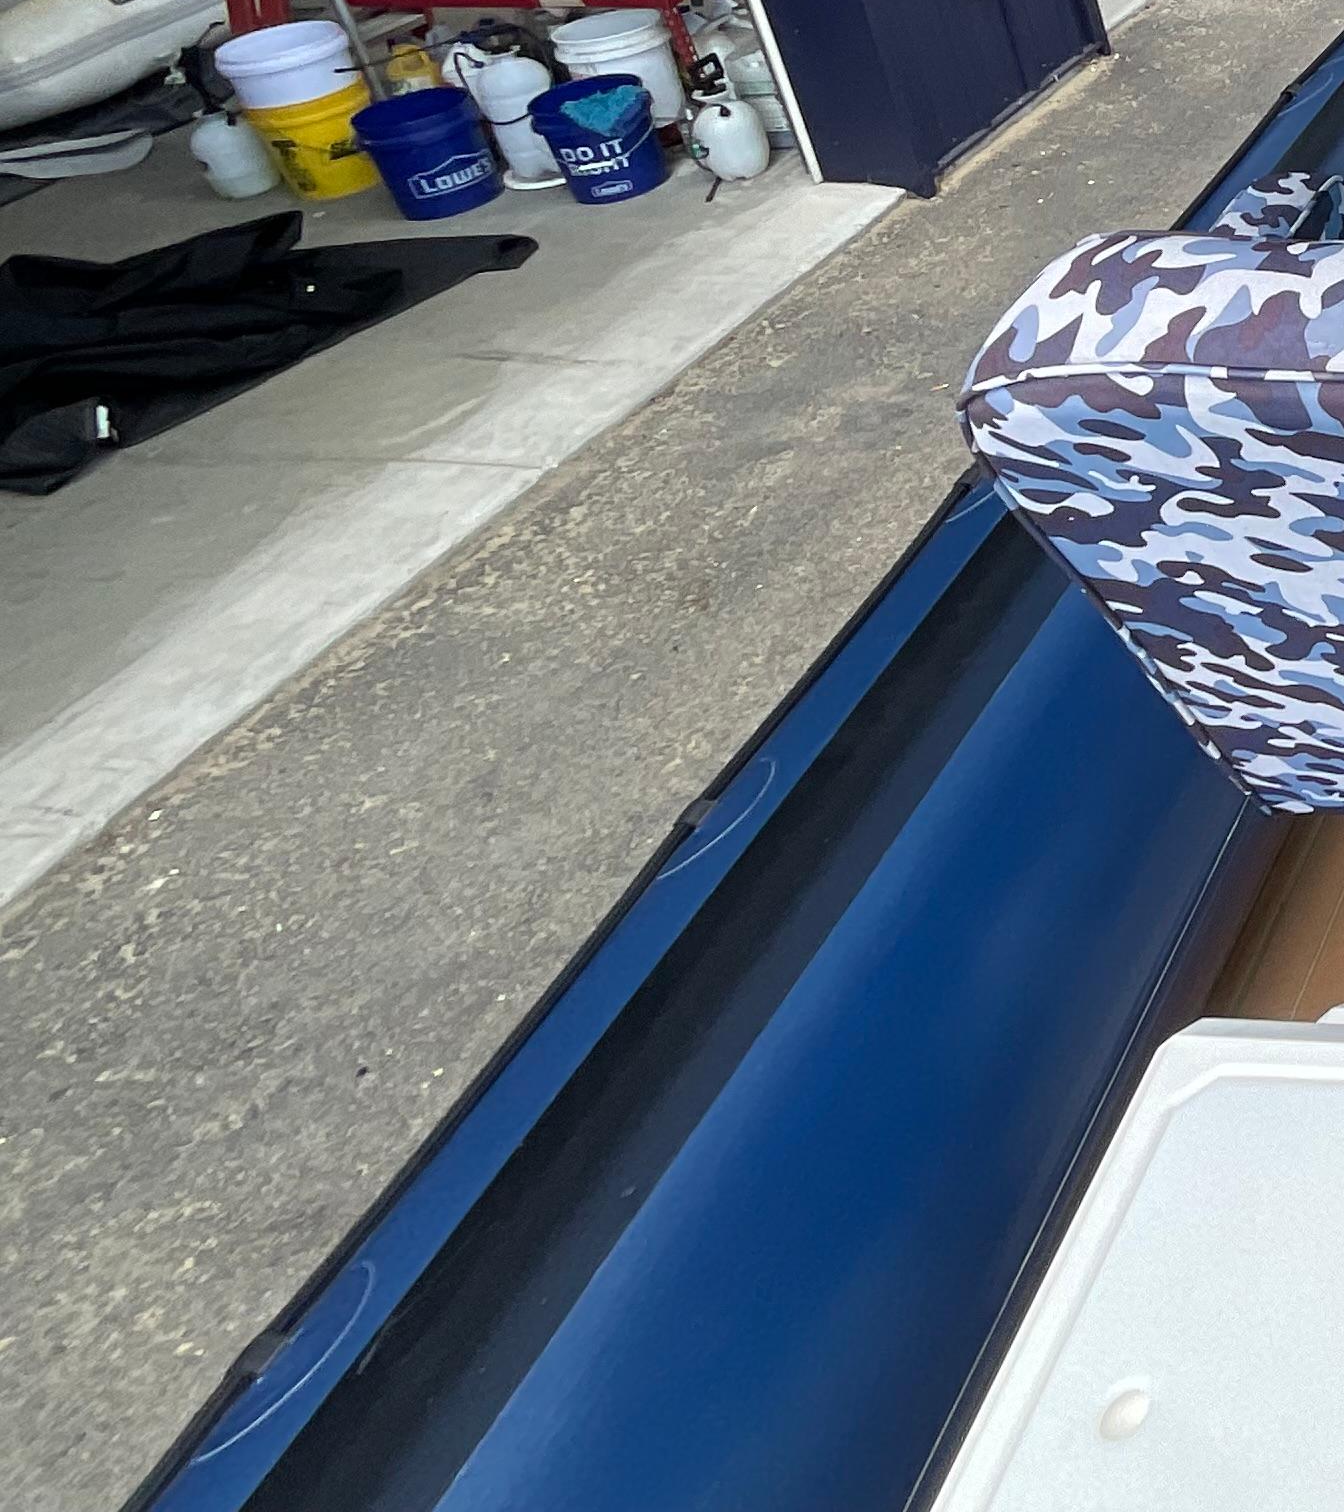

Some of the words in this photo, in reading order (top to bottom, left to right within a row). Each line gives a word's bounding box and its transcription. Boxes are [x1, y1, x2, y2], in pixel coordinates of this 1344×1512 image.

[560, 146, 594, 162] DO
[600, 138, 623, 157] IT
[567, 155, 629, 177] RHT
